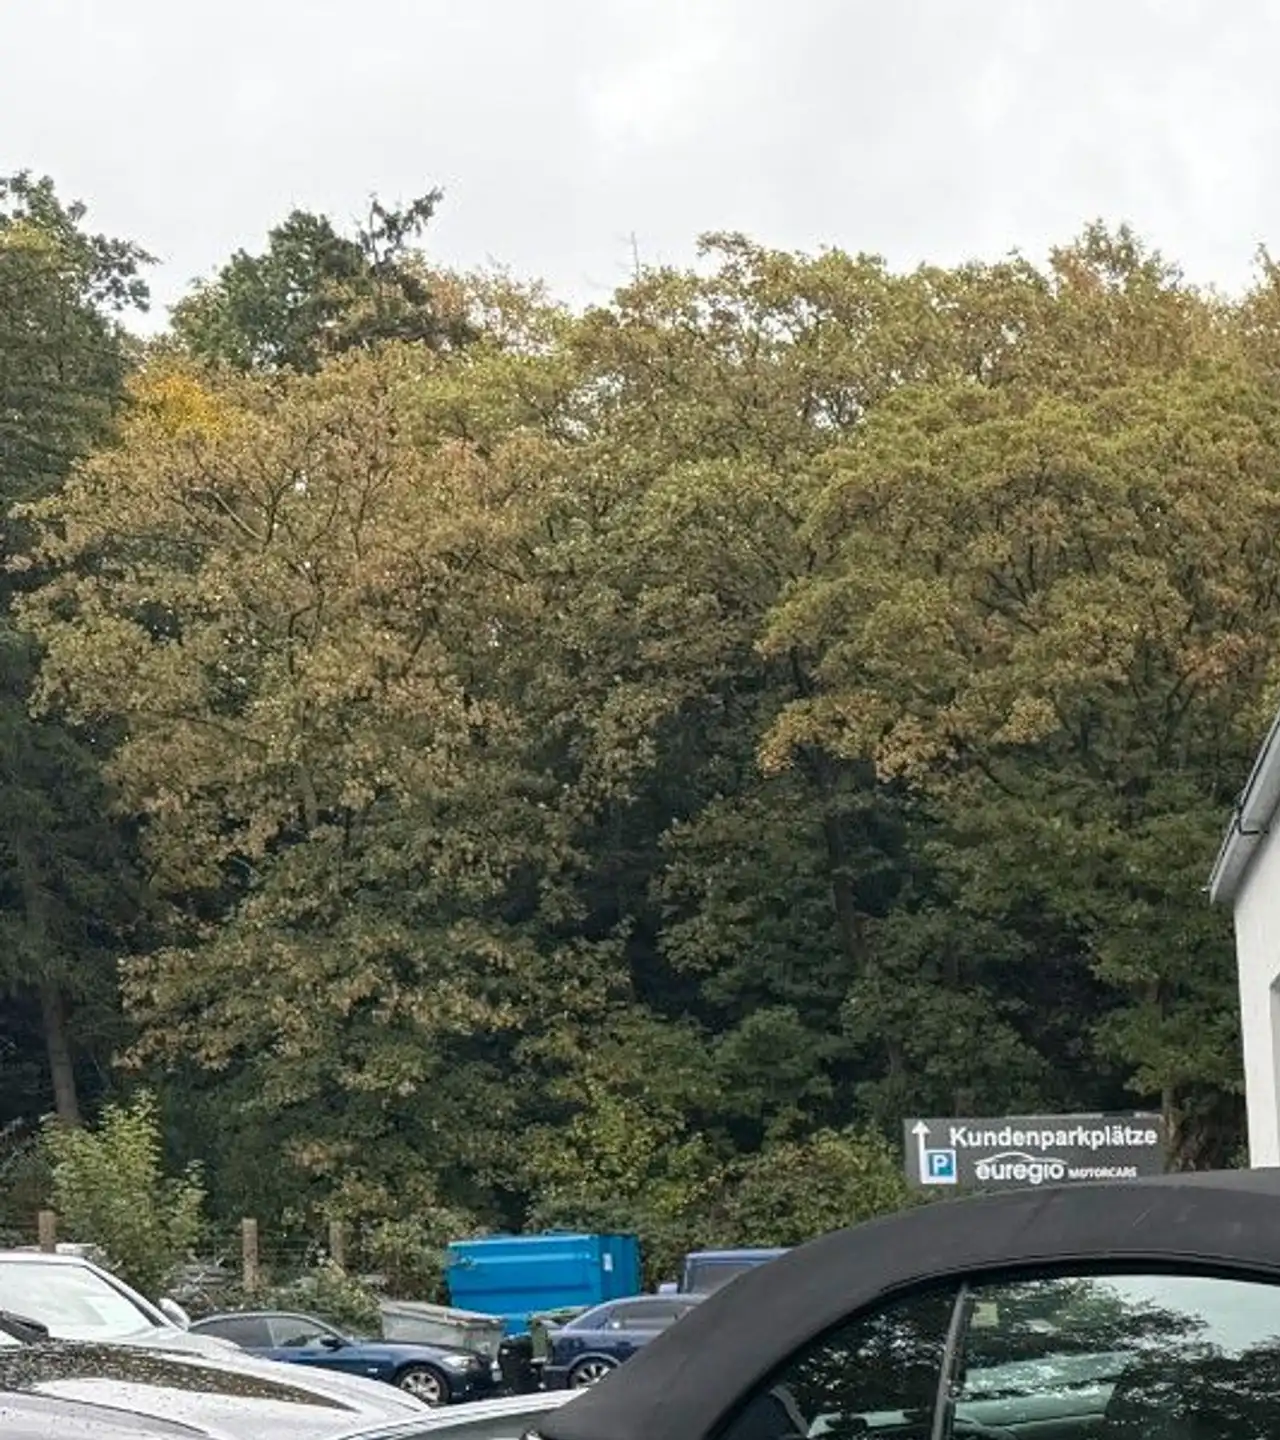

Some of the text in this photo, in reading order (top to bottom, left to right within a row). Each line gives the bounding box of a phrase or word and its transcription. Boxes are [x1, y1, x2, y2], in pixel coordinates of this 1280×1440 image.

[949, 1126, 1158, 1151] Kundenparkplätze
[975, 1161, 1137, 1184] euregio MOTORCARS
